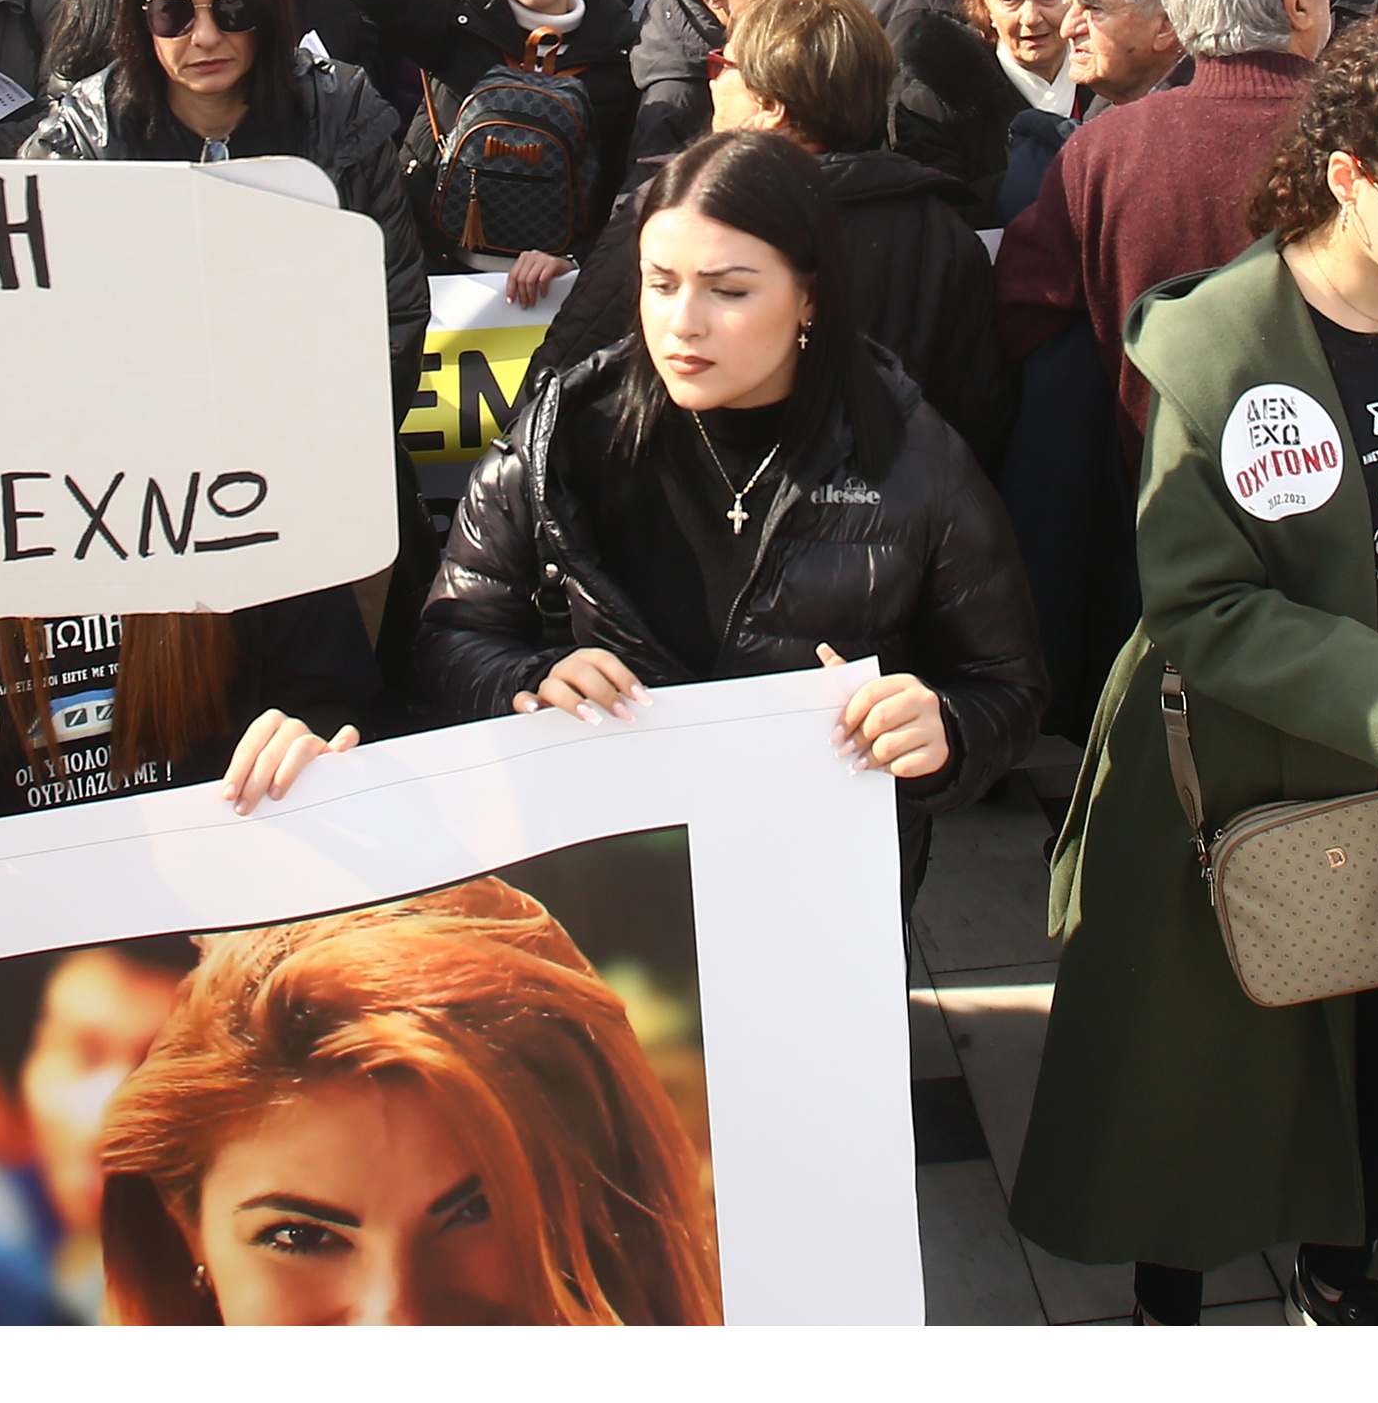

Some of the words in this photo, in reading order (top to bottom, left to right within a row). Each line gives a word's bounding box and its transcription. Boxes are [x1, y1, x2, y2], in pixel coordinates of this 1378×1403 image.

[1247, 396, 1298, 424] ΔΕΝ
[1249, 423, 1301, 449] ΕΧΩ
[810, 483, 882, 505] ellesse
[62, 668, 88, 685] ΕΙΣΤΕ
